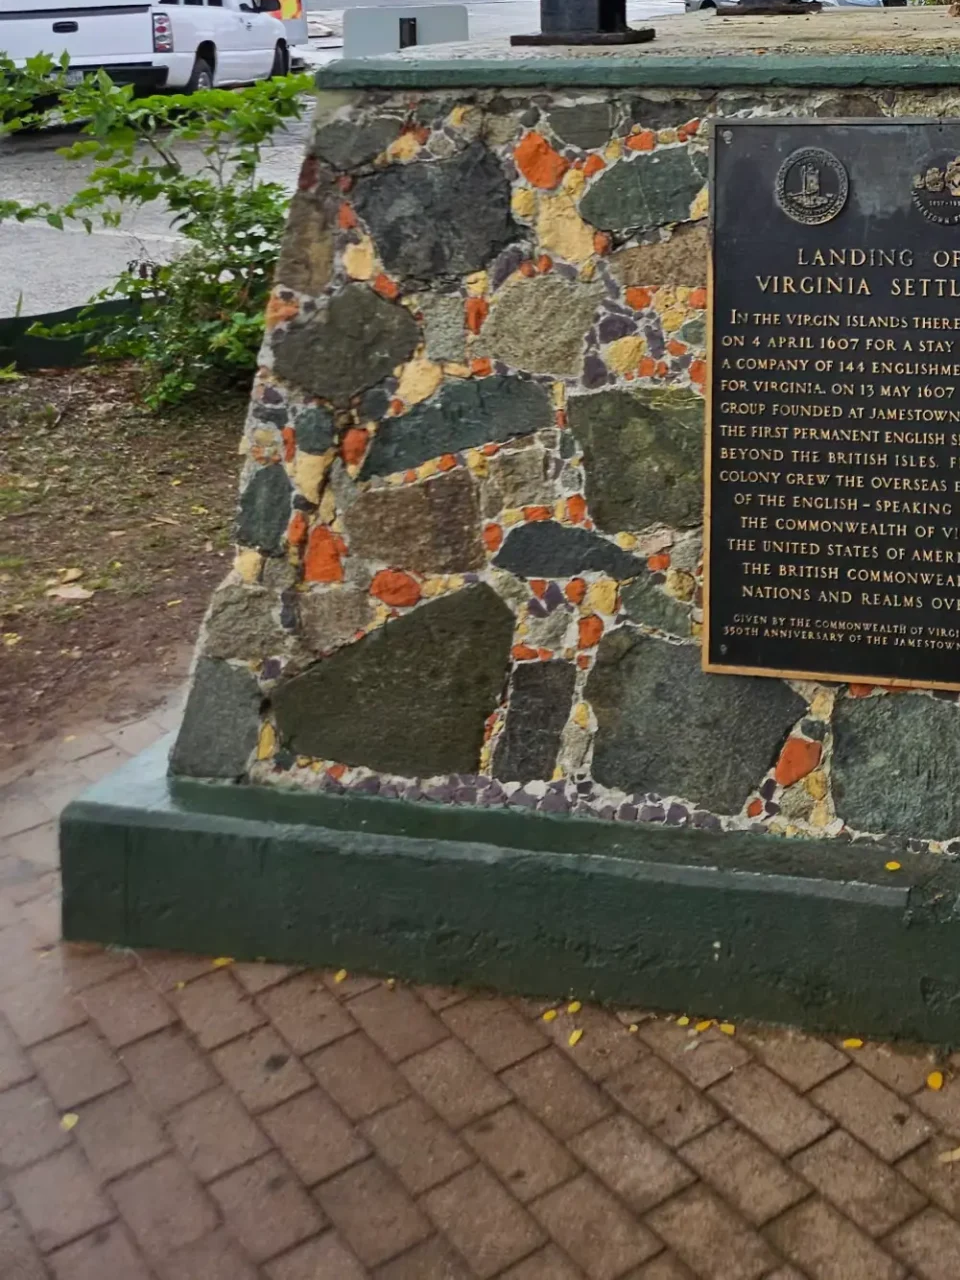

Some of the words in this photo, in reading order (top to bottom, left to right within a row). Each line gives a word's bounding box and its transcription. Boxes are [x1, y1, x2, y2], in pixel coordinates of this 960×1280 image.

[798, 248, 914, 266] LANDING
[756, 276, 871, 295] VIRGINIA
[753, 313, 781, 325] THE
[787, 314, 840, 327] VIRGIN
[847, 315, 908, 329] ISLANDS
[913, 317, 960, 329] THERE
[722, 335, 745, 347] ON
[752, 336, 761, 347] 4
[768, 336, 814, 349] APRIL
[820, 338, 859, 350] 1607
[866, 339, 896, 351] FOR
[903, 340, 913, 351] A
[919, 340, 953, 353] STAY
[722, 358, 731, 369] A
[736, 358, 809, 371] COMPANY
[815, 360, 834, 371] OF
[839, 361, 865, 372] 144
[721, 380, 748, 391] FOR
[832, 384, 855, 395] ON
[860, 385, 875, 397] 13
[880, 385, 911, 397] MAY
[917, 386, 954, 399] 1607
[721, 403, 766, 415] GROUP
[772, 405, 842, 417] FOUNDED
[848, 407, 865, 418] AT
[720, 426, 747, 437] THE
[751, 426, 788, 439] FIRST
[794, 428, 880, 442] PERMANENT
[885, 432, 945, 444] ENGLISH
[720, 448, 784, 462] BEYOND
[792, 451, 820, 463] THE
[829, 452, 887, 465] BRITISH
[895, 455, 939, 468] ISLES.
[720, 471, 779, 484] COLONY
[786, 474, 830, 486] GREW
[836, 475, 864, 488] THE
[871, 478, 947, 491] OVERSEAS
[734, 493, 752, 505] OF
[758, 495, 786, 507] THE
[793, 496, 858, 510] ENGLISH
[876, 500, 952, 515] SPEAKING
[741, 517, 768, 528] THE
[775, 518, 907, 536] COMMONWEALTH
[915, 525, 935, 537] OF
[727, 539, 756, 551] THE
[763, 541, 820, 555] UNITED
[827, 544, 879, 558] STATES
[887, 548, 906, 559] OF
[742, 563, 771, 575] THE
[779, 565, 839, 579] BRITISH
[742, 586, 810, 600] NATIONS
[818, 590, 852, 603] AND
[861, 593, 923, 608] REALMS
[734, 614, 767, 624] GIVEN
[773, 617, 786, 626] BY
[790, 618, 811, 627] THE
[816, 620, 906, 634] COMMONWEALTH
[911, 627, 924, 635] OF
[764, 628, 844, 642] ANNIVERSARY
[867, 636, 887, 645] THE
